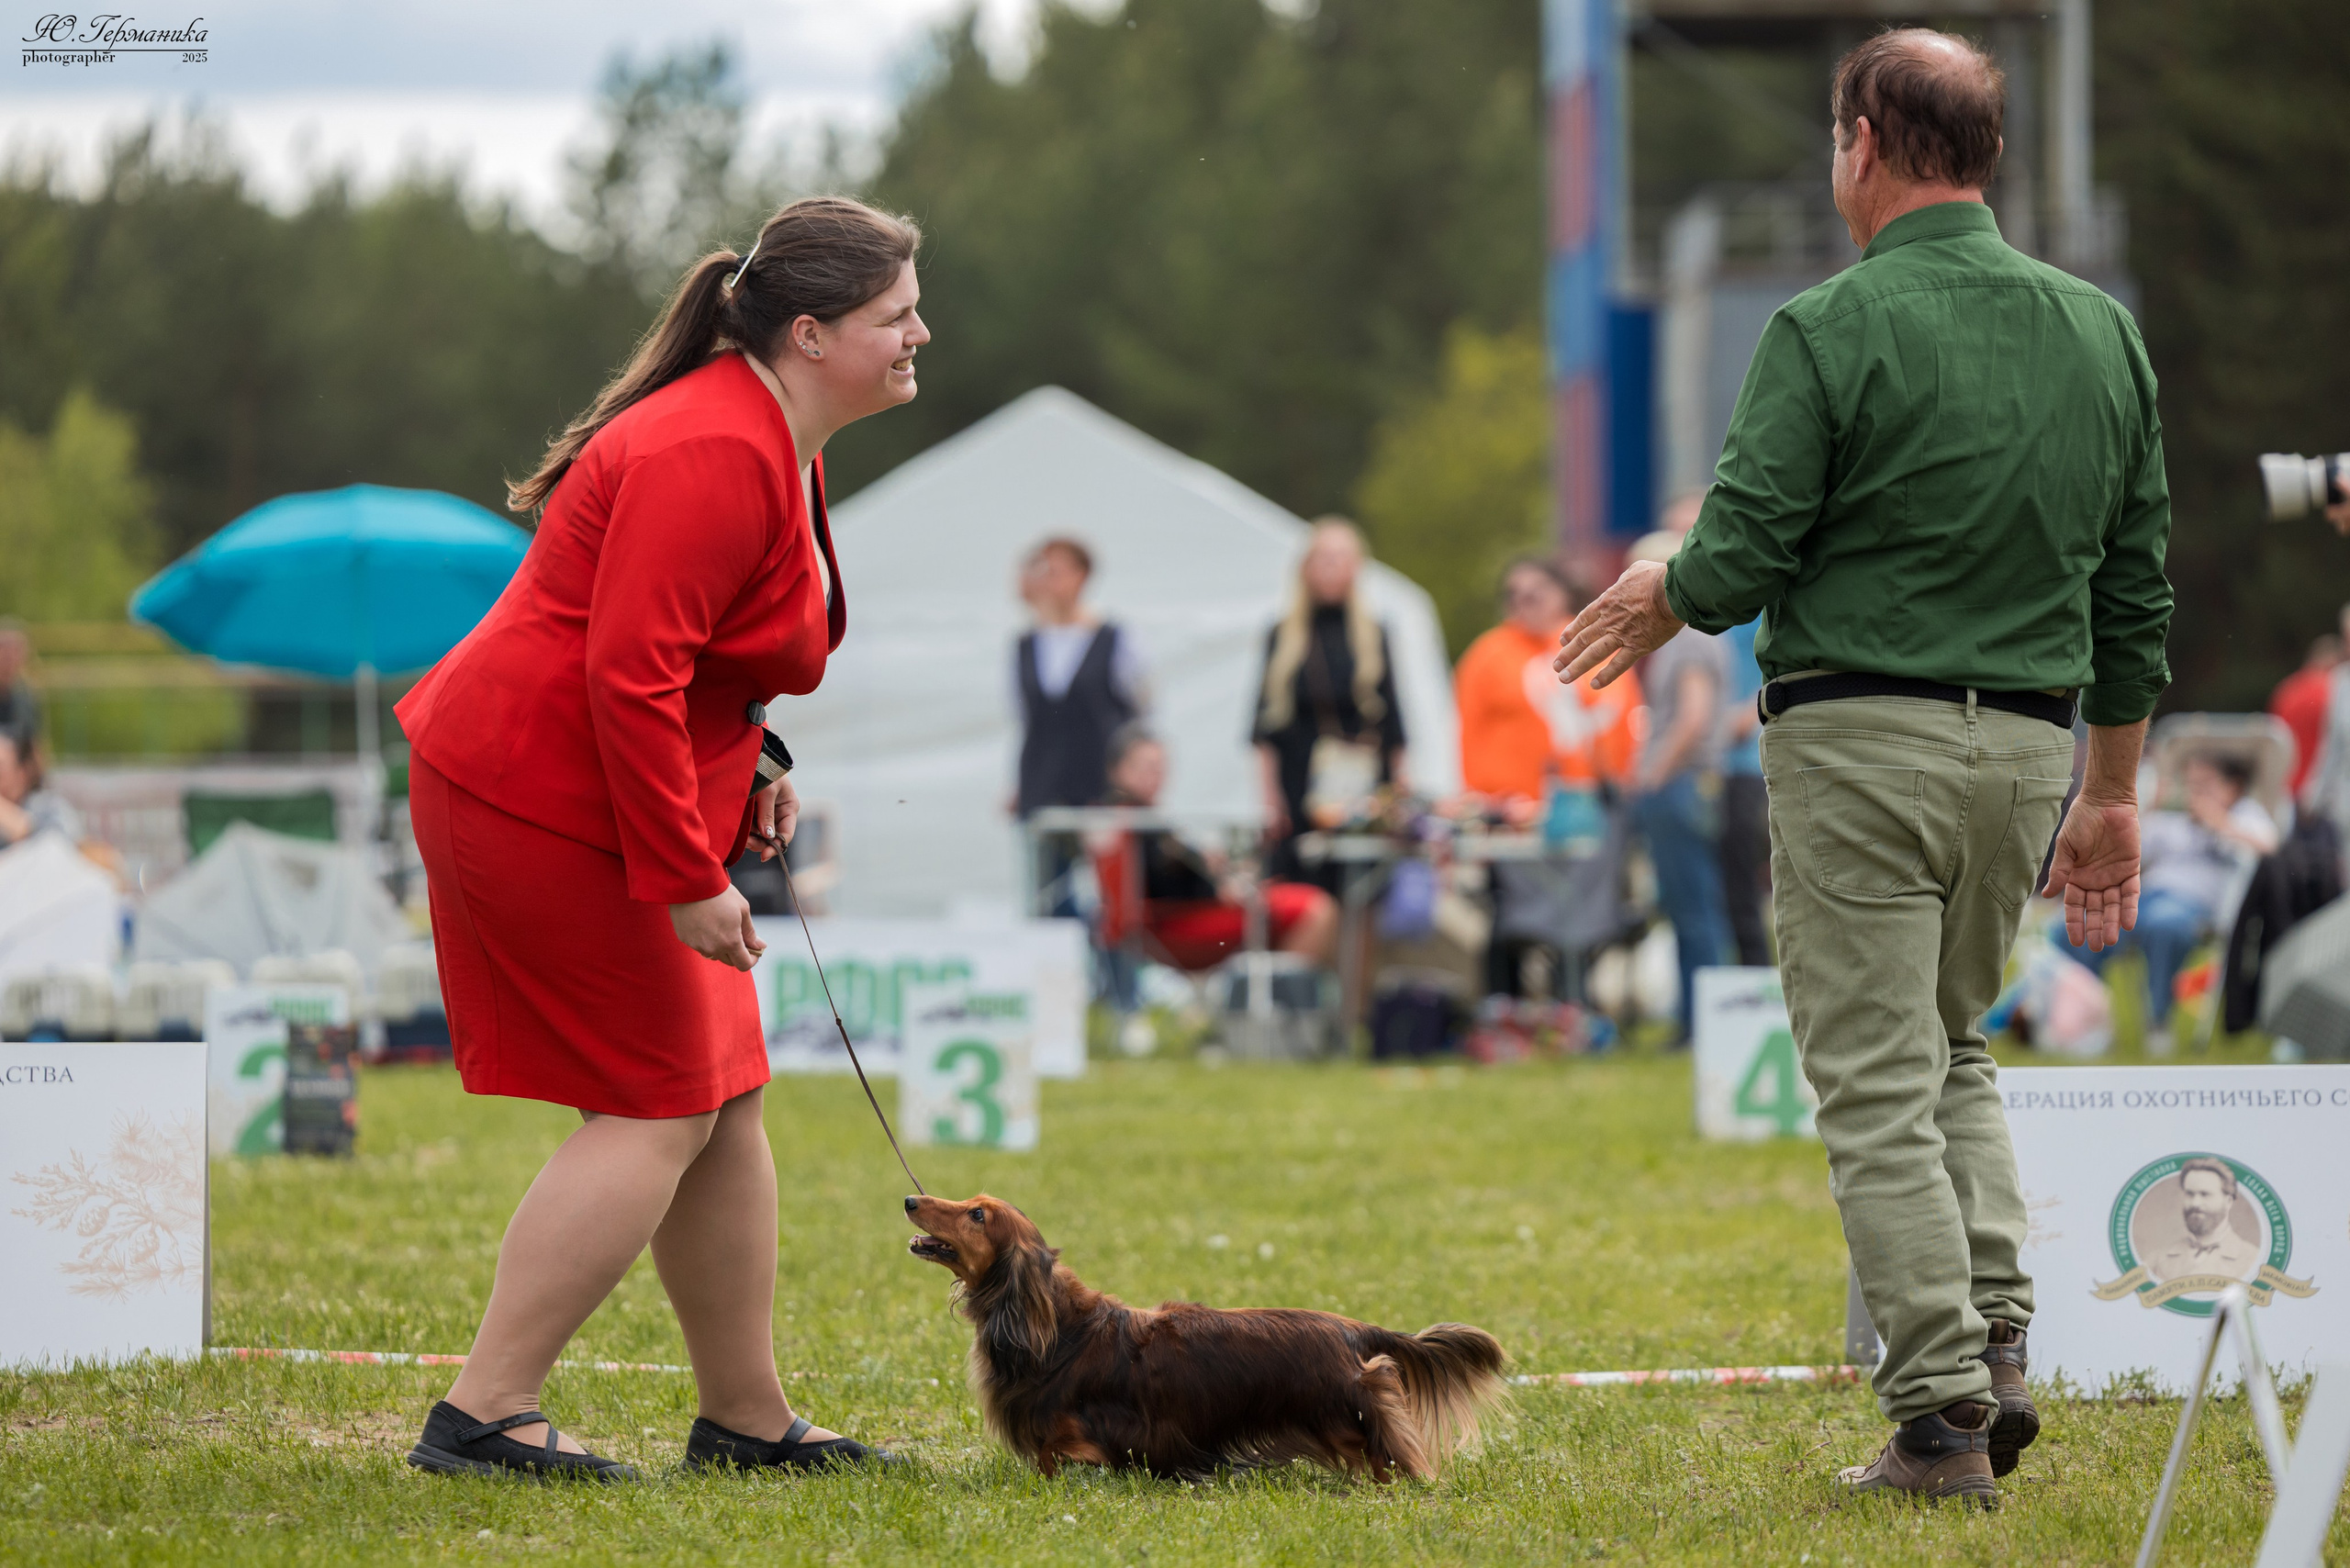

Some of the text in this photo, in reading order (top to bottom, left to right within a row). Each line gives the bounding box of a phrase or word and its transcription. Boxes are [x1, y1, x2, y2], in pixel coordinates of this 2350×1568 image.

[0, 1065, 73, 1086] СТВА
[934, 1038, 1003, 1148] 3
[1736, 1029, 1807, 1136] 4
[2004, 1091, 2115, 1112] ЕРАЦИЯ
[2122, 1088, 2322, 1109] ОХОТНИЧЬЕГО
